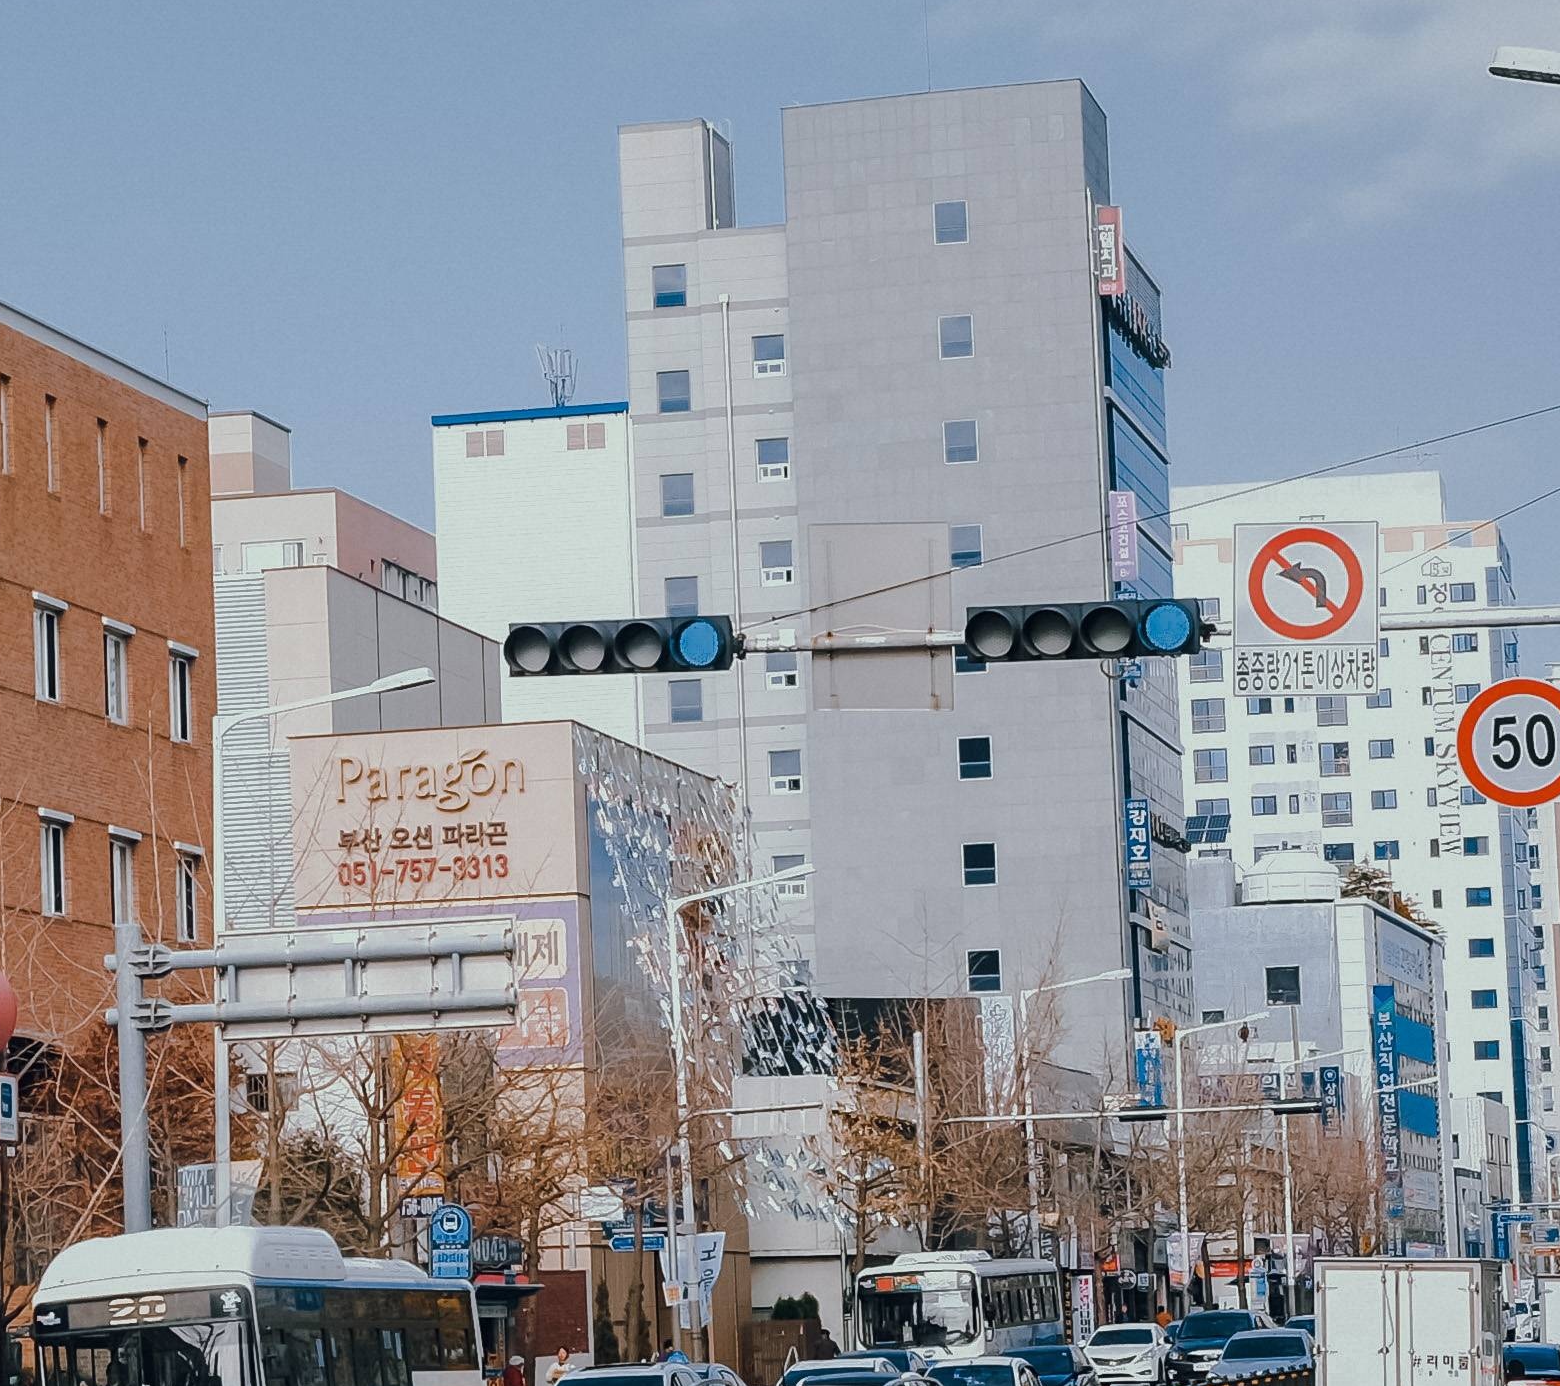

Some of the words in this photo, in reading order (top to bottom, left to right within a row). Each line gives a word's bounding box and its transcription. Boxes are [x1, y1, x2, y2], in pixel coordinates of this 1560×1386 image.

[1236, 649, 1375, 692] 총중량21톤이상차량
[1429, 633, 1455, 734] CENTUM
[1491, 713, 1556, 770] 50
[334, 748, 527, 812] Paragon
[1435, 742, 1462, 856] SKYVIEW
[442, 821, 508, 849] 파라곤
[108, 1294, 167, 1326] 20
